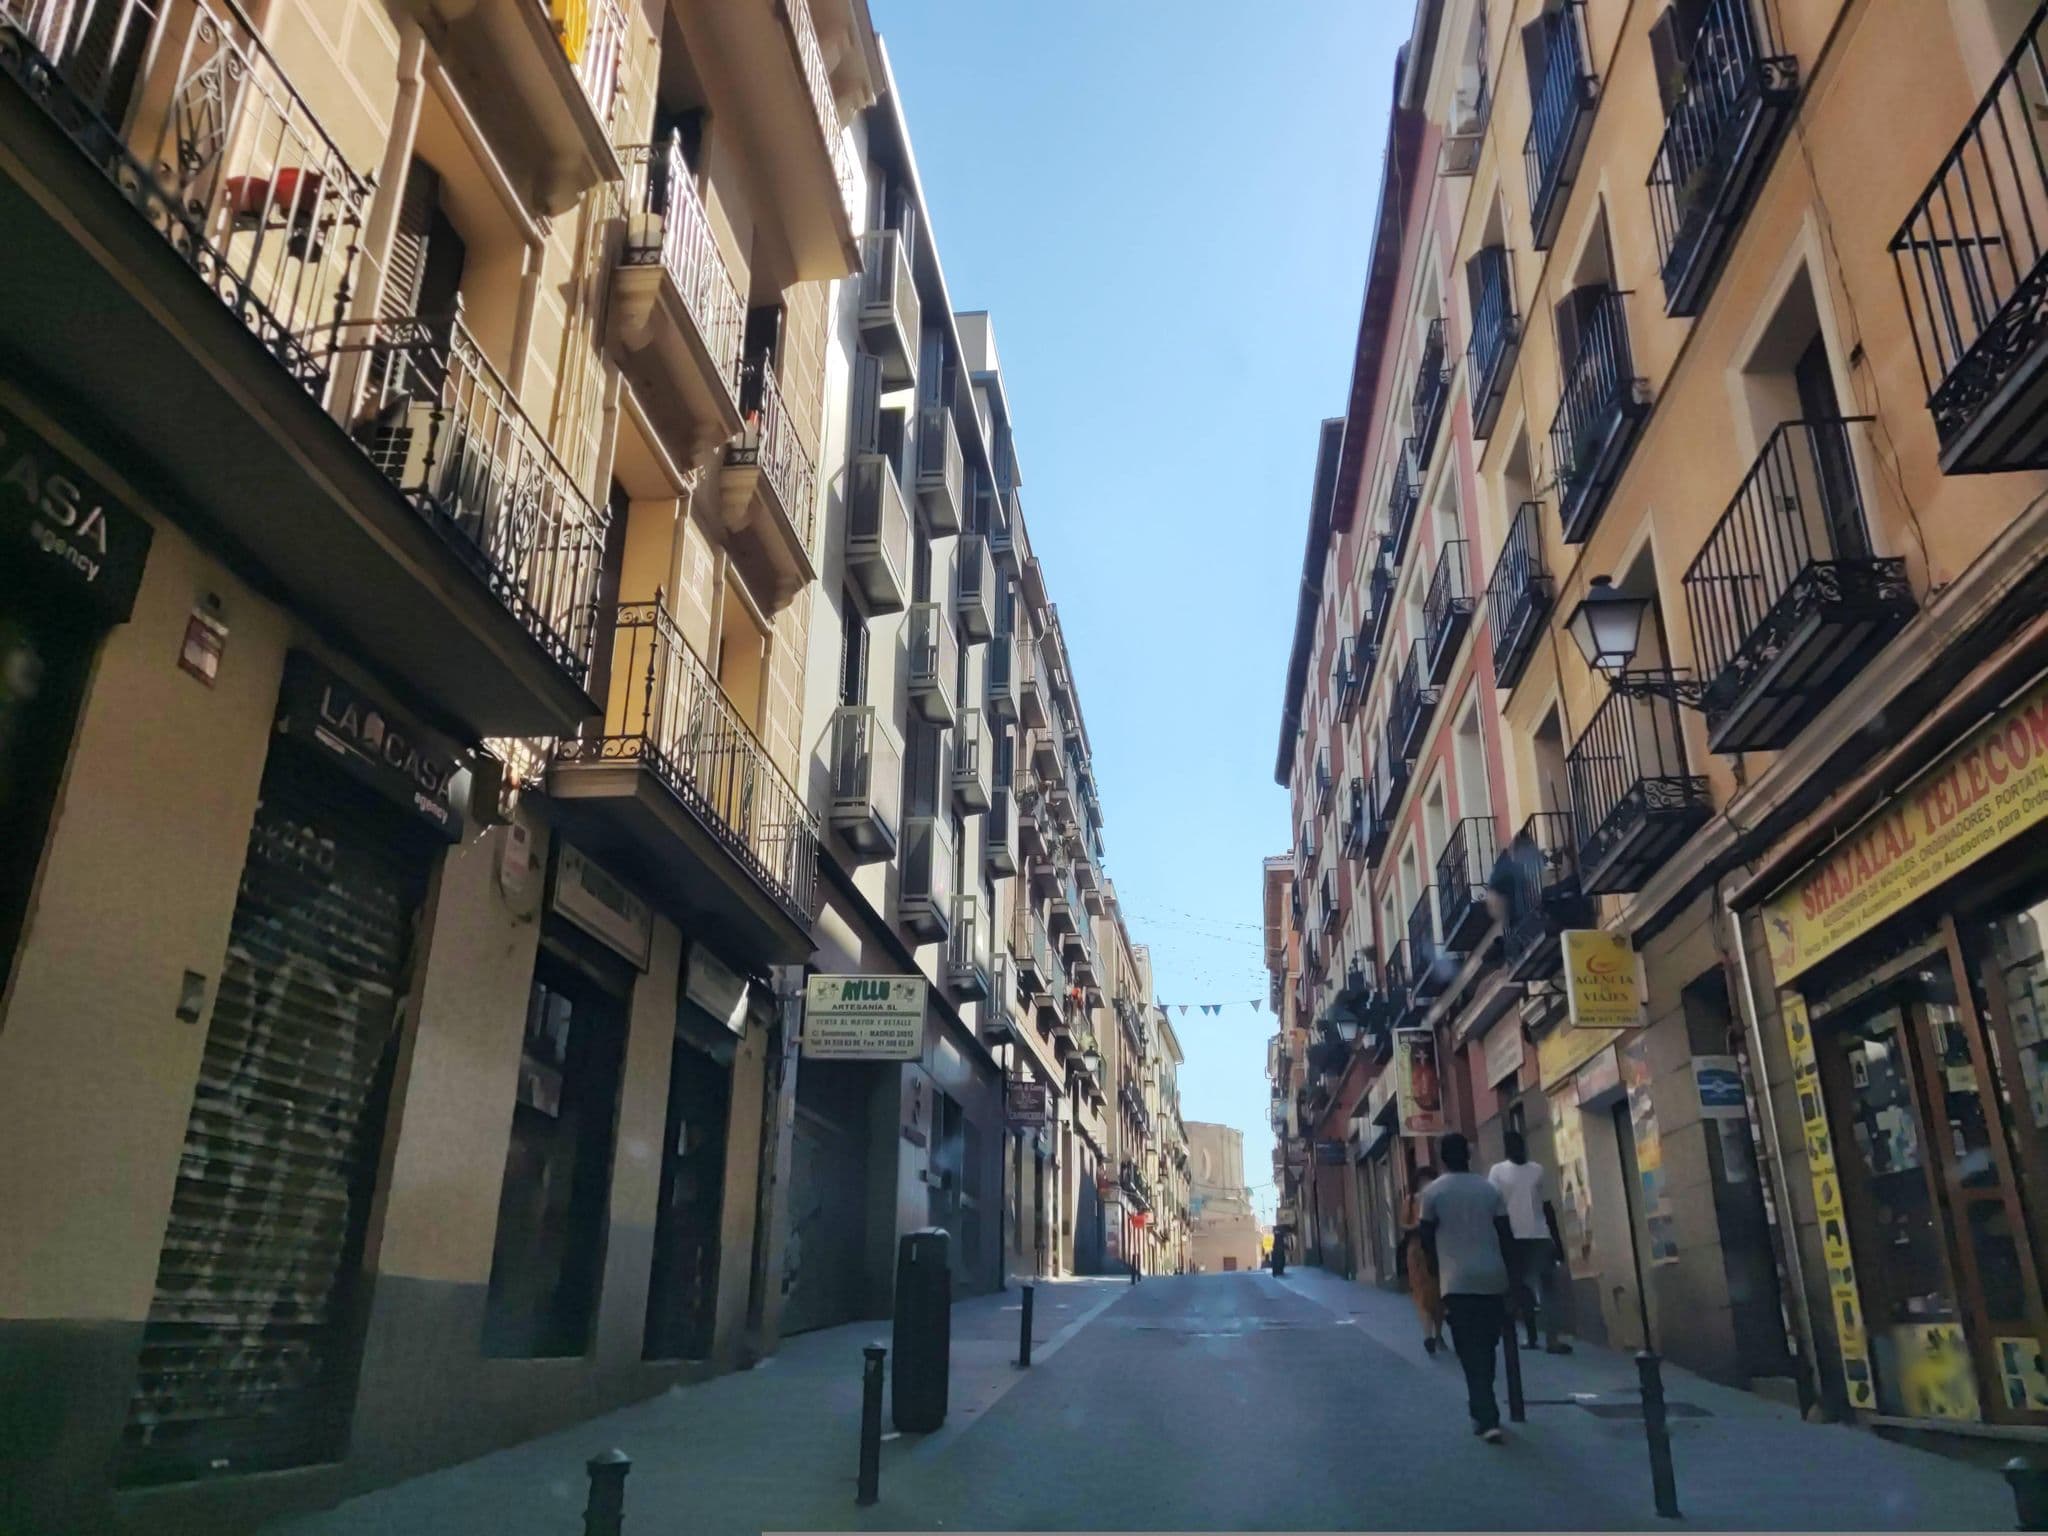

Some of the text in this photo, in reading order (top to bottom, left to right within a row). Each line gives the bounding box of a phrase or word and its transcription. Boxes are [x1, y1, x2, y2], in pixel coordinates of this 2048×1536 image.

[0, 430, 107, 554] ASA
[320, 686, 358, 738] LA
[1997, 809, 2021, 835] para
[1800, 808, 1917, 922] SHAJALAL
[841, 980, 891, 1002] AYLLU
[1576, 975, 1634, 985] AGENCIA
[1583, 991, 1629, 1001] VIAJES
